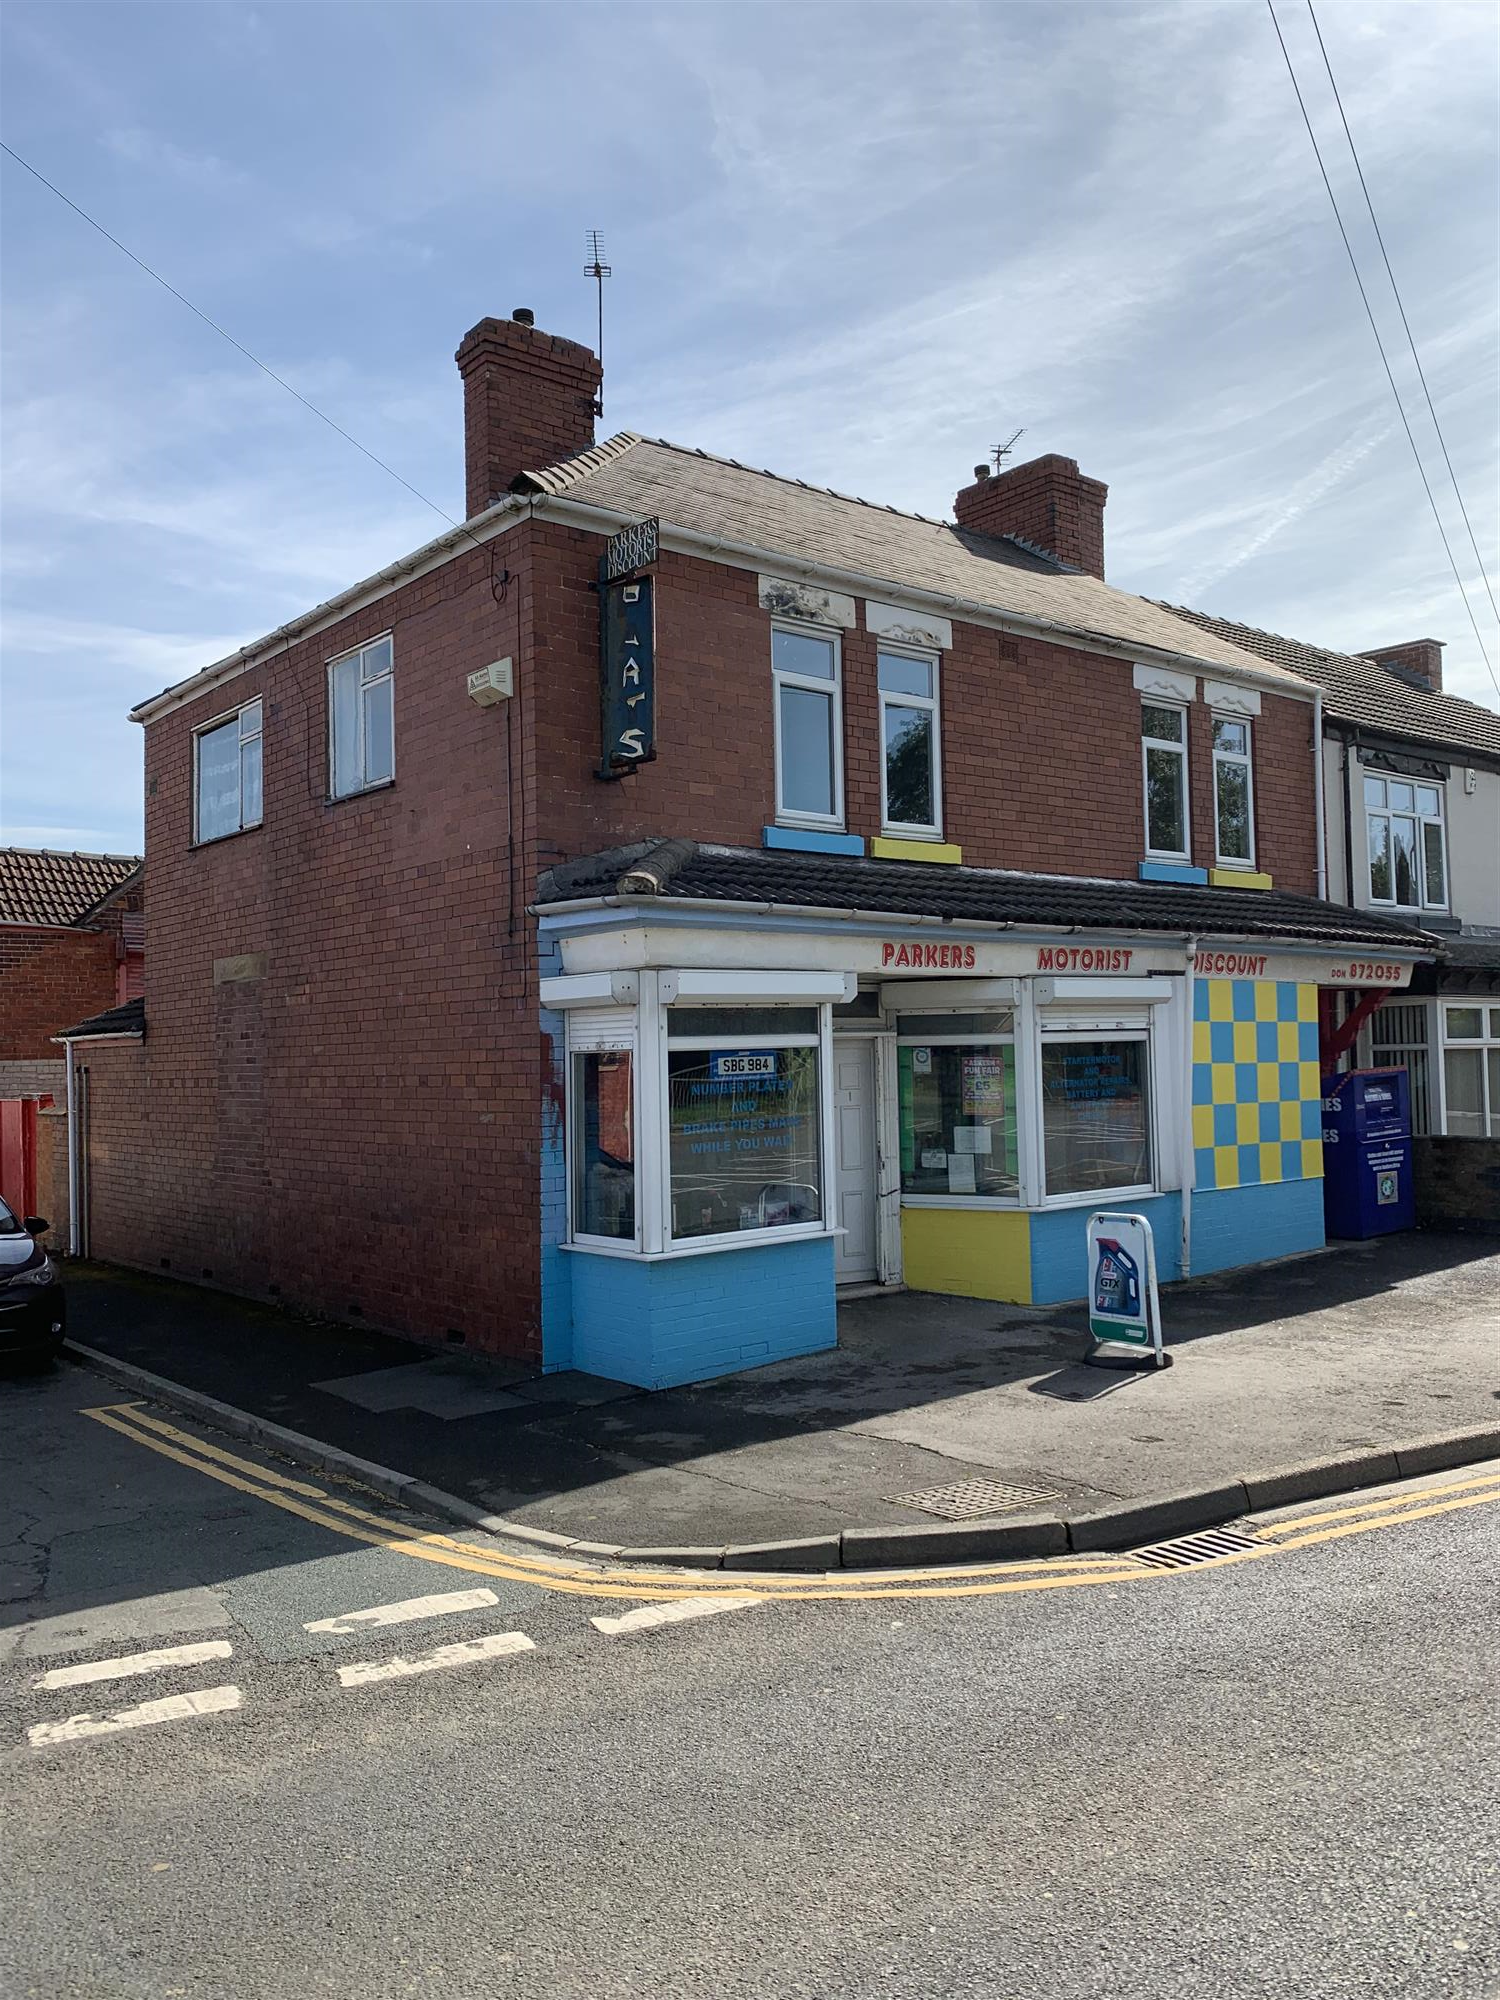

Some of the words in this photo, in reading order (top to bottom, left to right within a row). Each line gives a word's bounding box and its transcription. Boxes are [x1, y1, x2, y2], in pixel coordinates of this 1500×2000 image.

[607, 519, 658, 551] PARKERS
[607, 532, 657, 566] MOTORIST
[607, 545, 658, 580] DISCOUNT
[882, 943, 975, 969] PARKERS
[1037, 948, 1132, 971] MOTORIST
[1331, 969, 1346, 978] DON
[1350, 963, 1401, 980] 872055
[723, 1059, 745, 1072] SBG
[747, 1058, 769, 1071] 984
[964, 1066, 981, 1075] FUN
[982, 1066, 1001, 1075] FAIR
[691, 1082, 745, 1096] NUMBER
[975, 1080, 991, 1091] £5
[691, 1140, 731, 1153] WHILE
[736, 1138, 760, 1151] YOU
[1101, 1278, 1120, 1288] GTX
